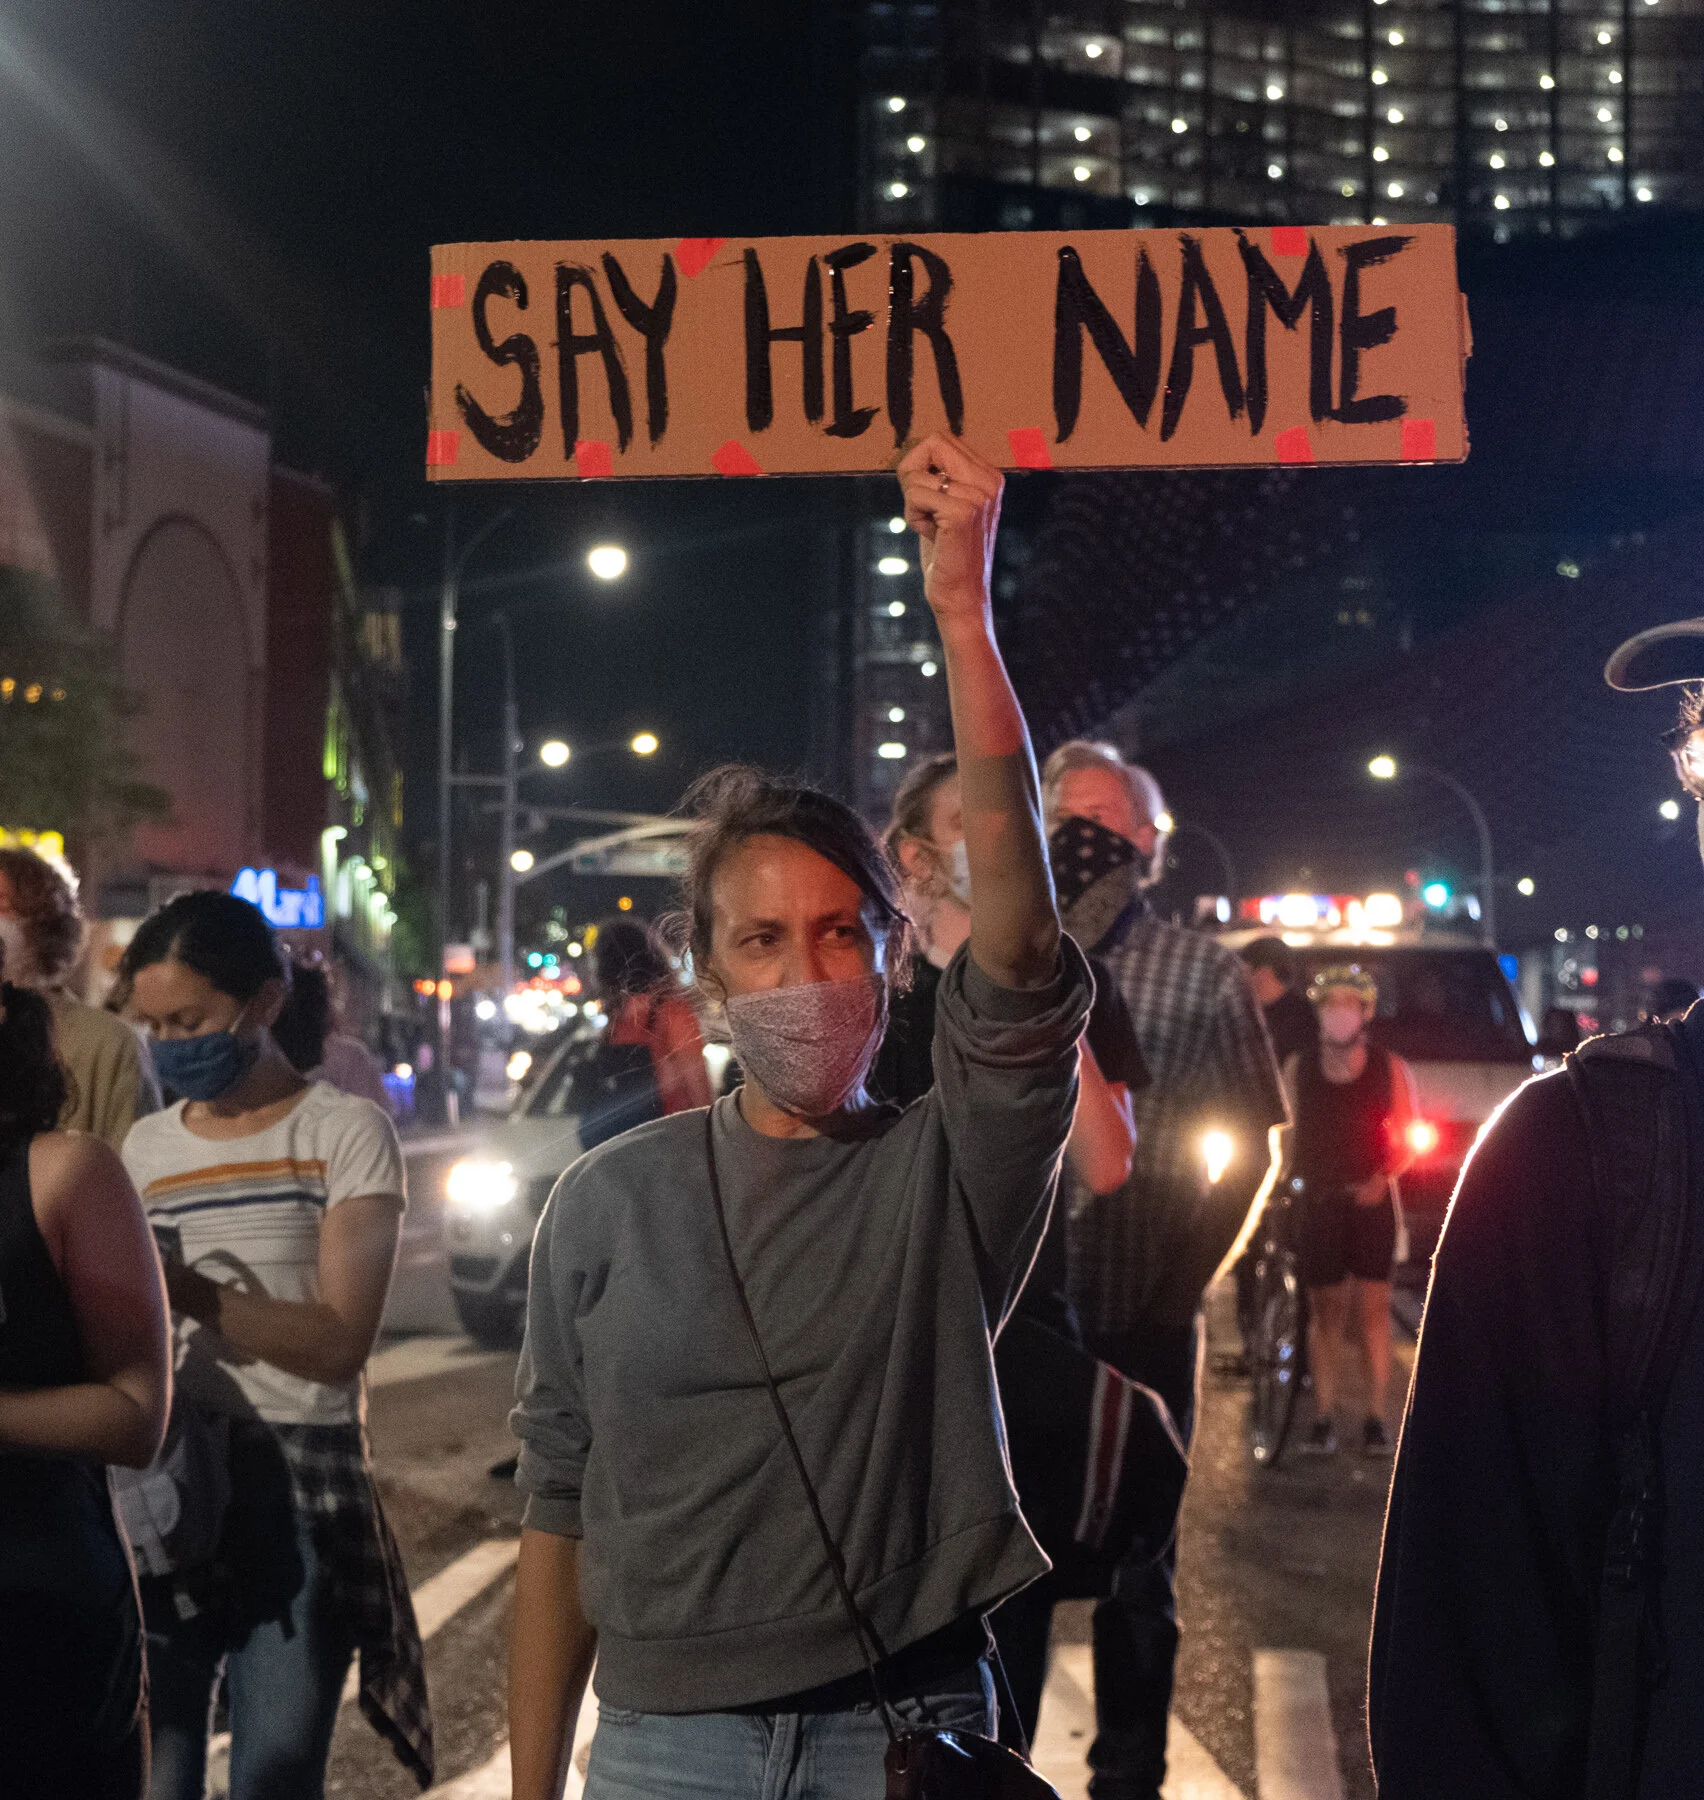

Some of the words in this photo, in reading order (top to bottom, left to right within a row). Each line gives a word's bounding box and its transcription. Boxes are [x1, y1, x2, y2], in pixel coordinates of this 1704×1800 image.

[456, 252, 677, 462] SAY
[743, 242, 963, 449] HER
[1053, 228, 1416, 443] NAME
